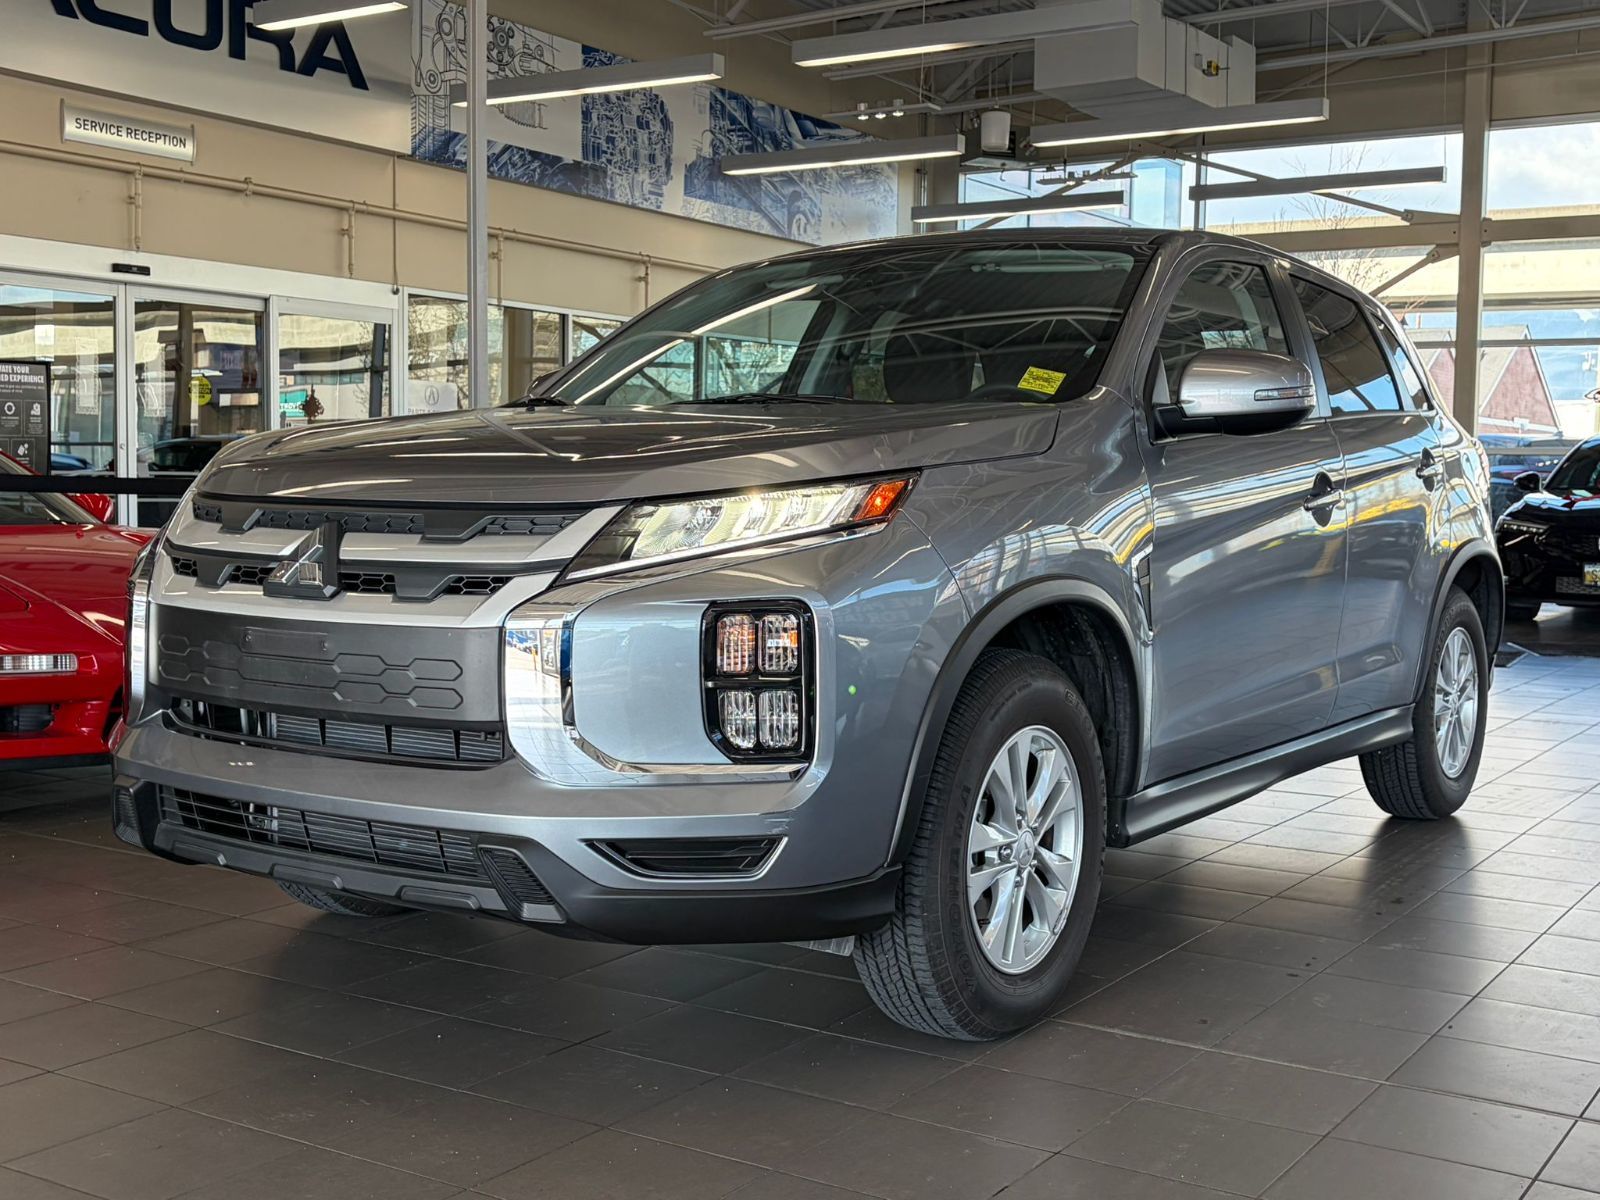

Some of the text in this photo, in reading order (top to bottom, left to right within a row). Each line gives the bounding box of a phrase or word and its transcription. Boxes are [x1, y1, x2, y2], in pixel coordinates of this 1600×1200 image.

[51, 0, 369, 91] CURA
[75, 117, 187, 149] SERVICE RECEPTION
[9, 374, 44, 384] EXPERIENCE
[13, 365, 30, 374] YOUR
